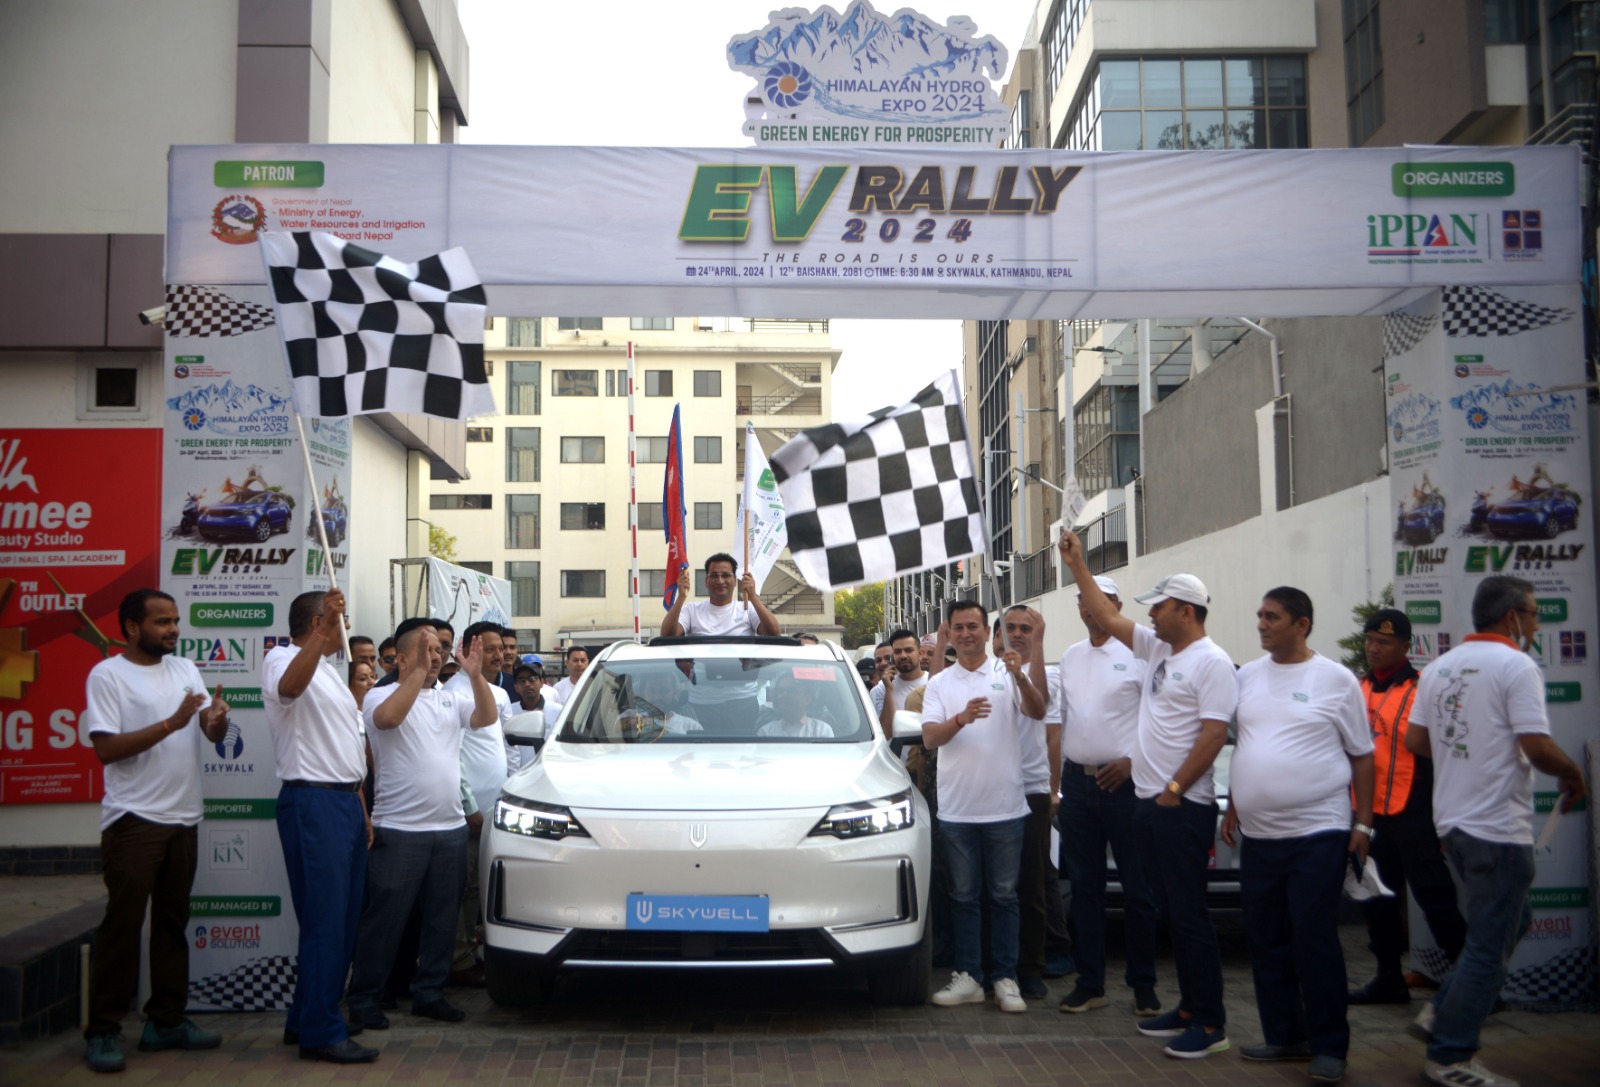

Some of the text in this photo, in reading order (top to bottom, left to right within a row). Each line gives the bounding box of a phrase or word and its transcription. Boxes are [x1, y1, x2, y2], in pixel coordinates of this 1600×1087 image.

[827, 79, 985, 94] HIMALAYAN HYDRO
[881, 94, 985, 113] EXPO 2024
[760, 126, 993, 143] GREEN ENERGY FOR PROSPERITY
[243, 165, 295, 181] PATRON
[1402, 171, 1504, 185] ORGANIZERS
[271, 198, 353, 207] Government of Nepal
[678, 164, 1084, 241] EV RALLY
[279, 208, 364, 219] Ministry of Energy,
[280, 220, 426, 231] Water Resources and Irrigation
[841, 218, 972, 243] 2024
[333, 231, 393, 242] Board Nepal
[763, 253, 995, 264] THE ROAD IS OURS
[743, 266, 764, 277] 2024
[843, 267, 863, 277] 2081
[900, 267, 919, 277] 6:30
[921, 267, 934, 277] AM
[946, 267, 989, 278] SKYWALK,
[991, 267, 1044, 279] KATHMANDU,
[1047, 268, 1073, 278] NEPAL
[213, 416, 289, 424] HIMALAYAN HYDRO
[1495, 413, 1570, 422] HIMALAYAN HYDRO
[239, 423, 289, 433] EXPO 2024
[1521, 423, 1543, 431] EXPO
[181, 438, 293, 447] GREEN ENERGY FOR PROSPERITY
[1465, 436, 1575, 446] GREEN ENERGY FOR PROSPERITY
[0, 531, 84, 550] auty Studio
[18, 555, 40, 563] NAIL
[48, 555, 65, 563] SPA
[72, 554, 119, 563] ACADEMY
[171, 548, 296, 575] EV RALLY
[1464, 544, 1584, 572] EV RALLY
[221, 565, 262, 574] 2024
[20, 593, 87, 612] OUTLET
[197, 609, 267, 619] ORGANIZERS
[179, 638, 247, 661] PPAN
[204, 763, 254, 773] SKYWALK
[203, 804, 253, 813] SUPPORTER
[1528, 893, 1568, 903] ANAGED
[211, 902, 259, 910] MANAGED
[261, 902, 273, 910] BY
[657, 906, 759, 921] SKYWELL
[210, 923, 261, 939] event
[210, 939, 260, 949] SOLUTION
